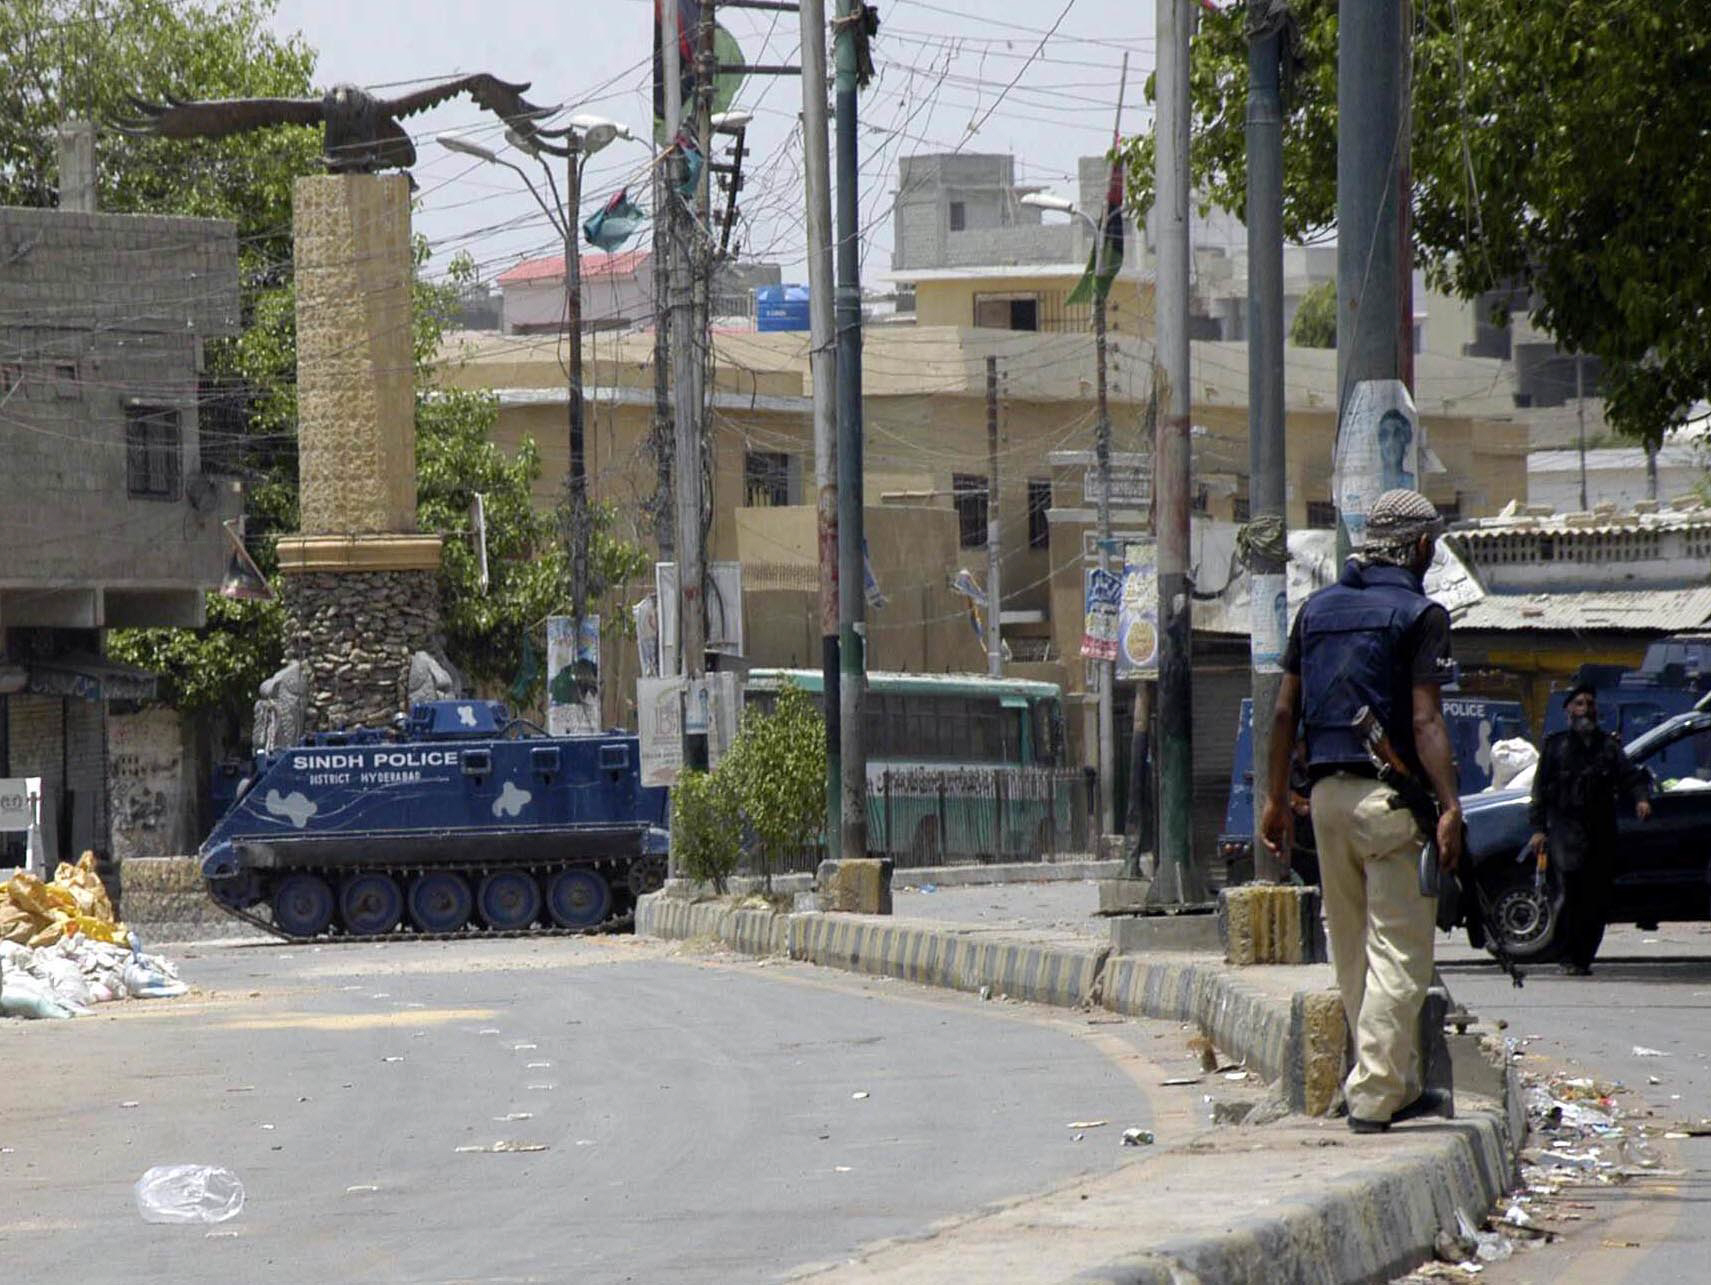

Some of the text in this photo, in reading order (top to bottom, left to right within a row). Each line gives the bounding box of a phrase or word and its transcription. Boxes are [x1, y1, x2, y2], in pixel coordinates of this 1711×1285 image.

[1443, 703, 1485, 717] POLICE
[293, 752, 458, 769] SINDH POLICE
[310, 771, 421, 785] DISTRICT HYDERABAD
